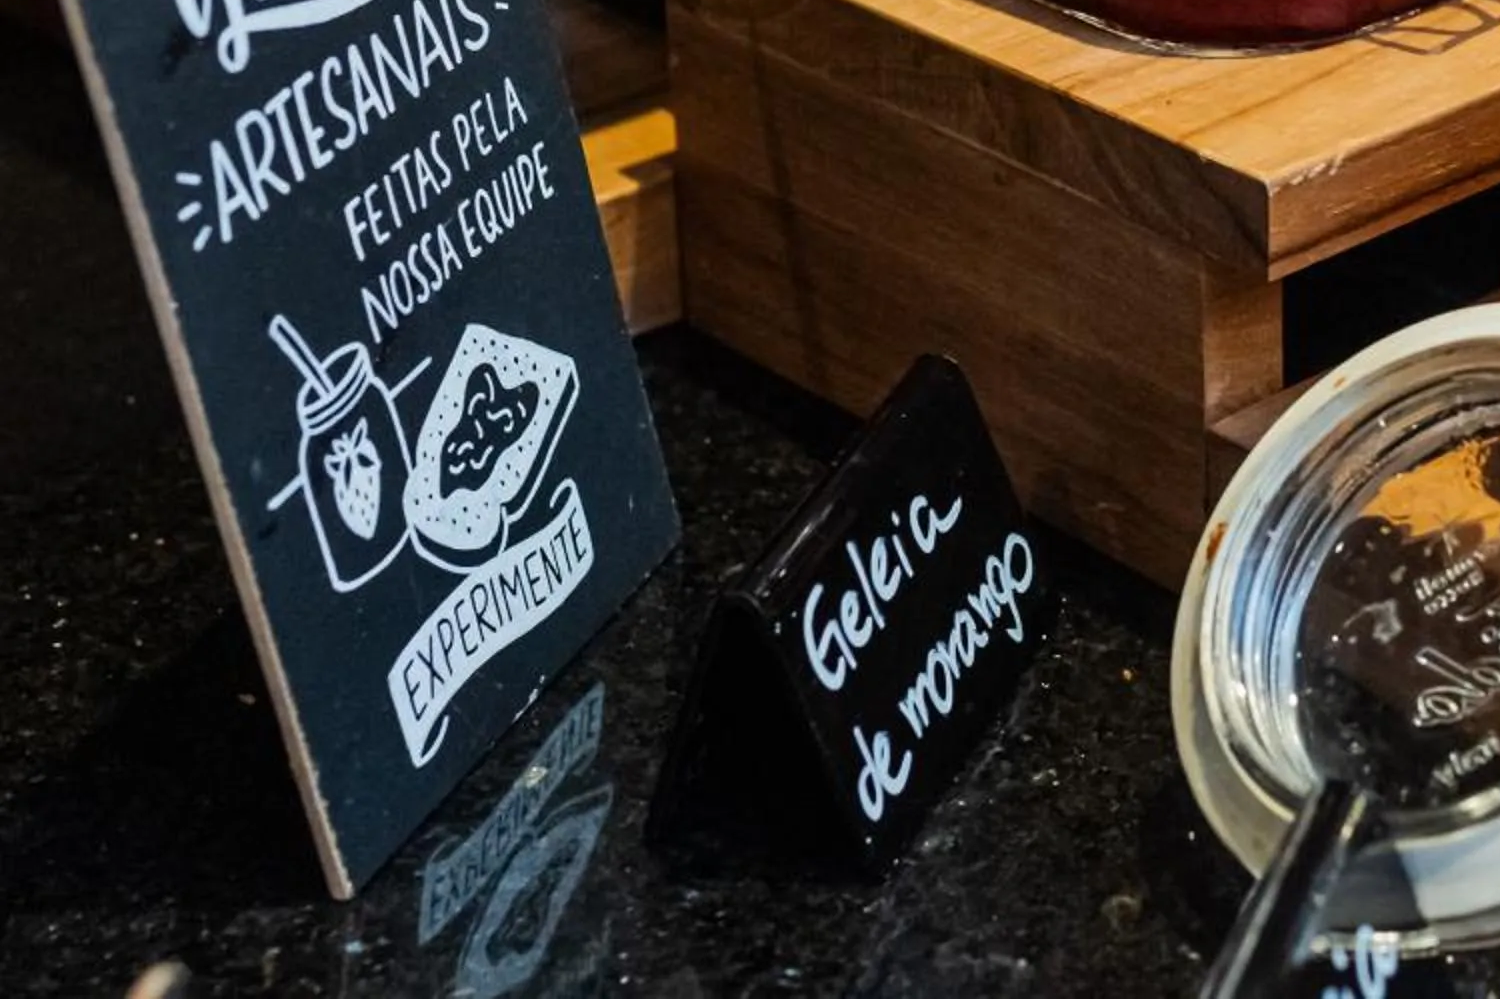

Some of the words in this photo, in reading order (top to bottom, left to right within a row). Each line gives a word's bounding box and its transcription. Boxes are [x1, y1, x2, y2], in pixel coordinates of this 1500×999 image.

[343, 130, 452, 262] FEITAS
[452, 76, 529, 172] PELA
[360, 231, 463, 344] NOSSA
[457, 140, 555, 258] EQUIPE
[402, 507, 590, 722] EXPERIMENTE
[803, 494, 962, 691] Geleia
[853, 726, 913, 822] de
[898, 532, 1034, 739] morango
